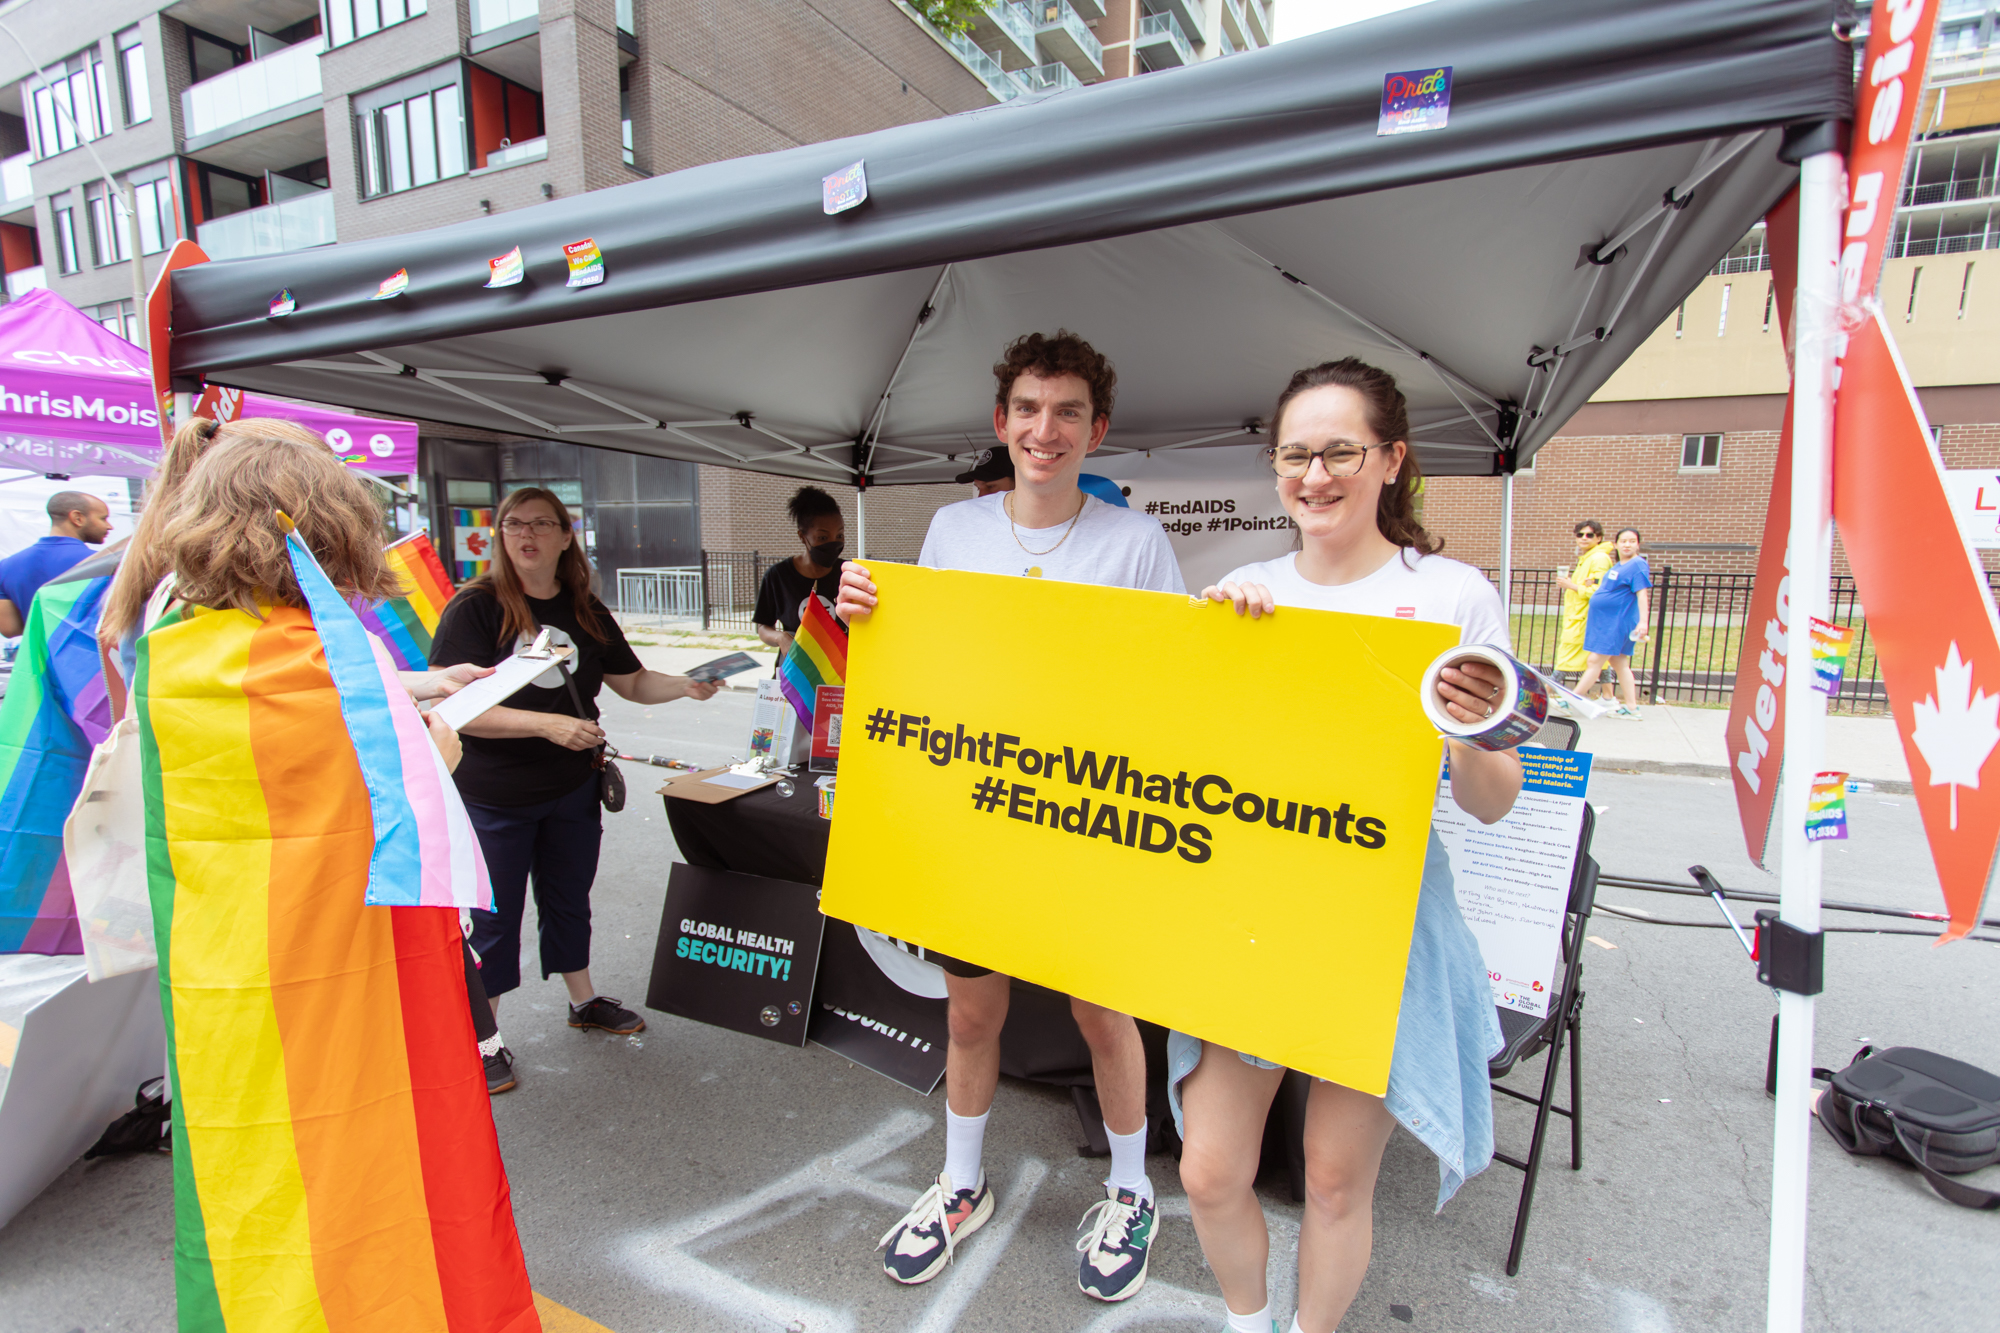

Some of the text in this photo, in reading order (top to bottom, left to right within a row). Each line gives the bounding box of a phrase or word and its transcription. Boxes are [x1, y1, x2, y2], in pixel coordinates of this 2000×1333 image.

[1387, 69, 1445, 104] Pride
[825, 164, 863, 194] Pride
[0, 385, 158, 427] hrisMois
[1145, 499, 1236, 515] #EndAIDS
[1161, 518, 1202, 536] edge
[1737, 560, 1791, 796] Metto
[1526, 753, 1564, 763] leadership
[1542, 763, 1563, 771] (MPs)
[865, 707, 1388, 850] #FightForWhatCounts
[1540, 771, 1564, 779] Global
[1543, 779, 1574, 788] Malaria.
[971, 775, 1213, 864] #EndAIDS
[680, 918, 795, 956] GLOBAL HEALTH
[675, 937, 792, 982] SECURITY!
[1518, 999, 1541, 1009] GLOBAL
[1518, 1003, 1534, 1011] FUND
